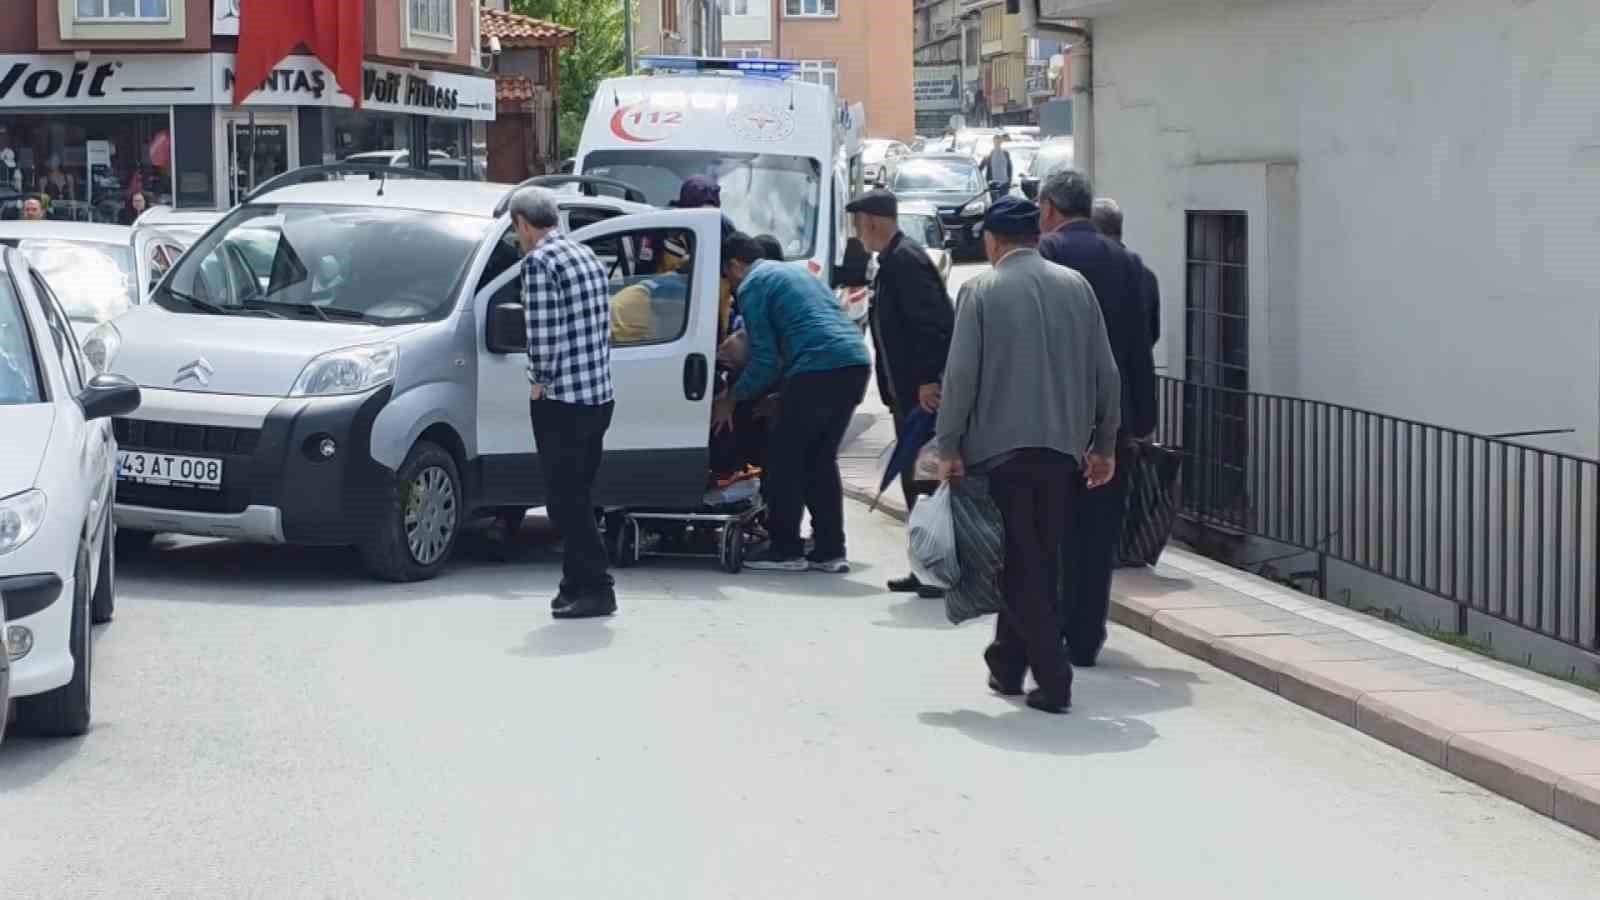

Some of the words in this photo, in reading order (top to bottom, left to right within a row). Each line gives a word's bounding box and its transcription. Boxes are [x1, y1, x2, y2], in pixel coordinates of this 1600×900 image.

[223, 67, 325, 99] NNTAŞ
[363, 68, 402, 104] Voit
[403, 74, 458, 110] Fitness
[628, 110, 683, 125] 112
[121, 454, 145, 474] 43
[151, 456, 175, 477] AT
[180, 459, 218, 481] 008
